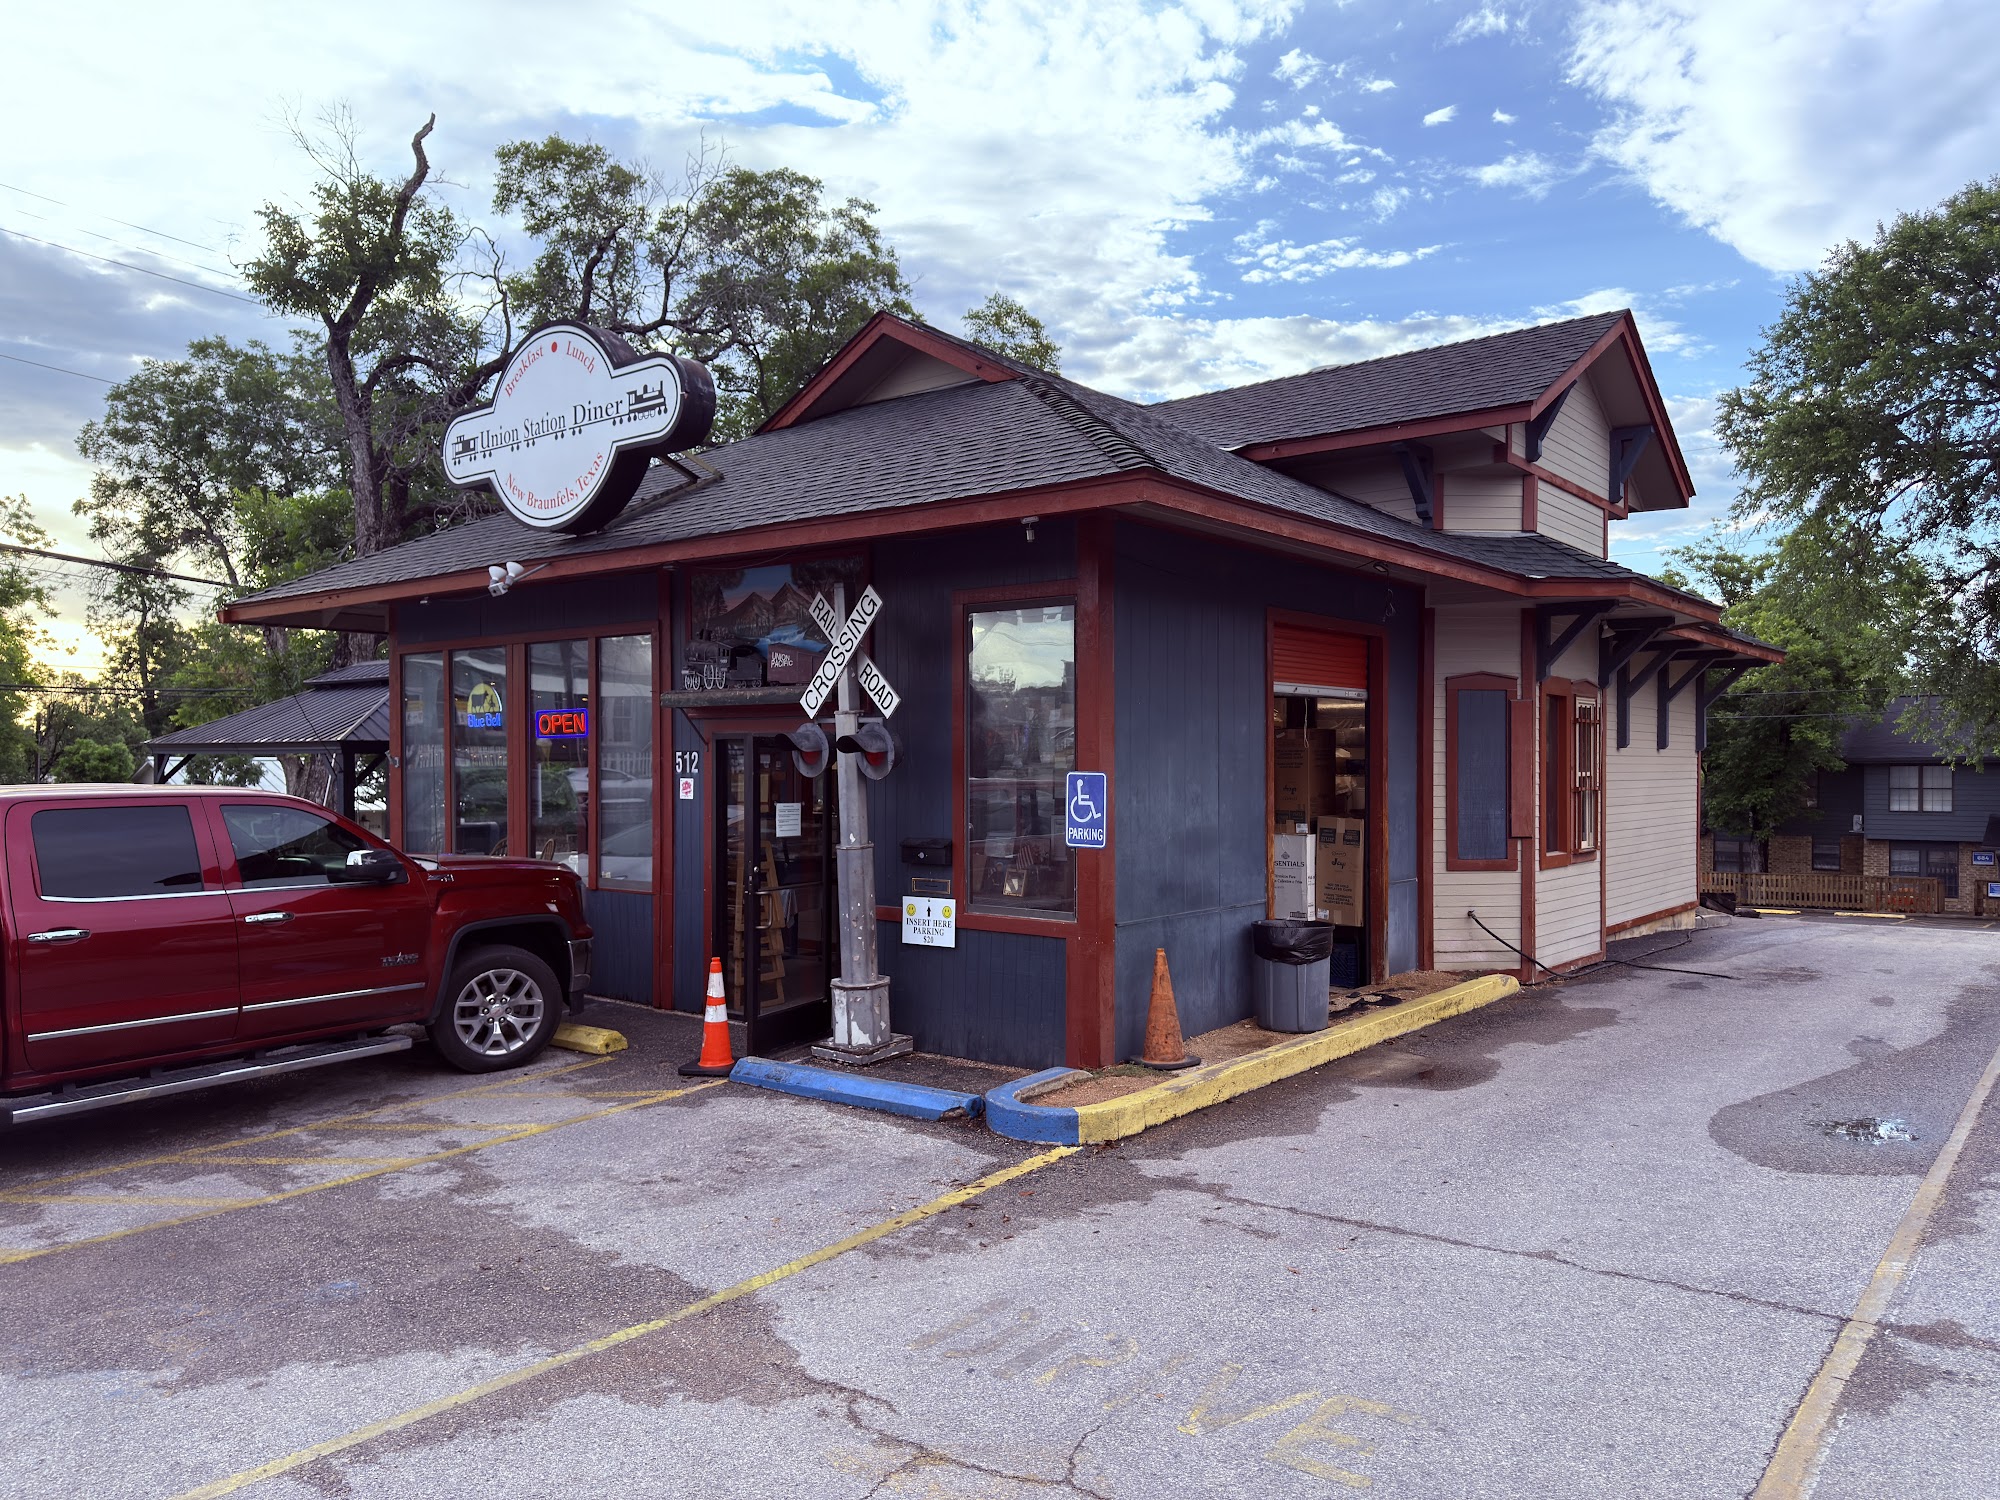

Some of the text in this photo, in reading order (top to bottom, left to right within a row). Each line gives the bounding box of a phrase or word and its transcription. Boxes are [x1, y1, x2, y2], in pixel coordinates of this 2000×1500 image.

[505, 340, 595, 397] Breakfast Lunch
[480, 400, 623, 450] Union Station Diner
[506, 453, 604, 510] New Braunfels, Texas
[812, 597, 836, 639] RAIL
[770, 658, 793, 668] PACIFIC
[771, 651, 790, 661] UNION
[805, 594, 878, 710] CROSSING
[860, 662, 894, 710] ROAD
[467, 713, 501, 728] Blue Bell
[539, 712, 586, 735] OPEN
[675, 751, 699, 773] 512
[1069, 827, 1103, 841] PARKING
[906, 917, 952, 928] INSERT HERE
[913, 926, 944, 936] PARKING
